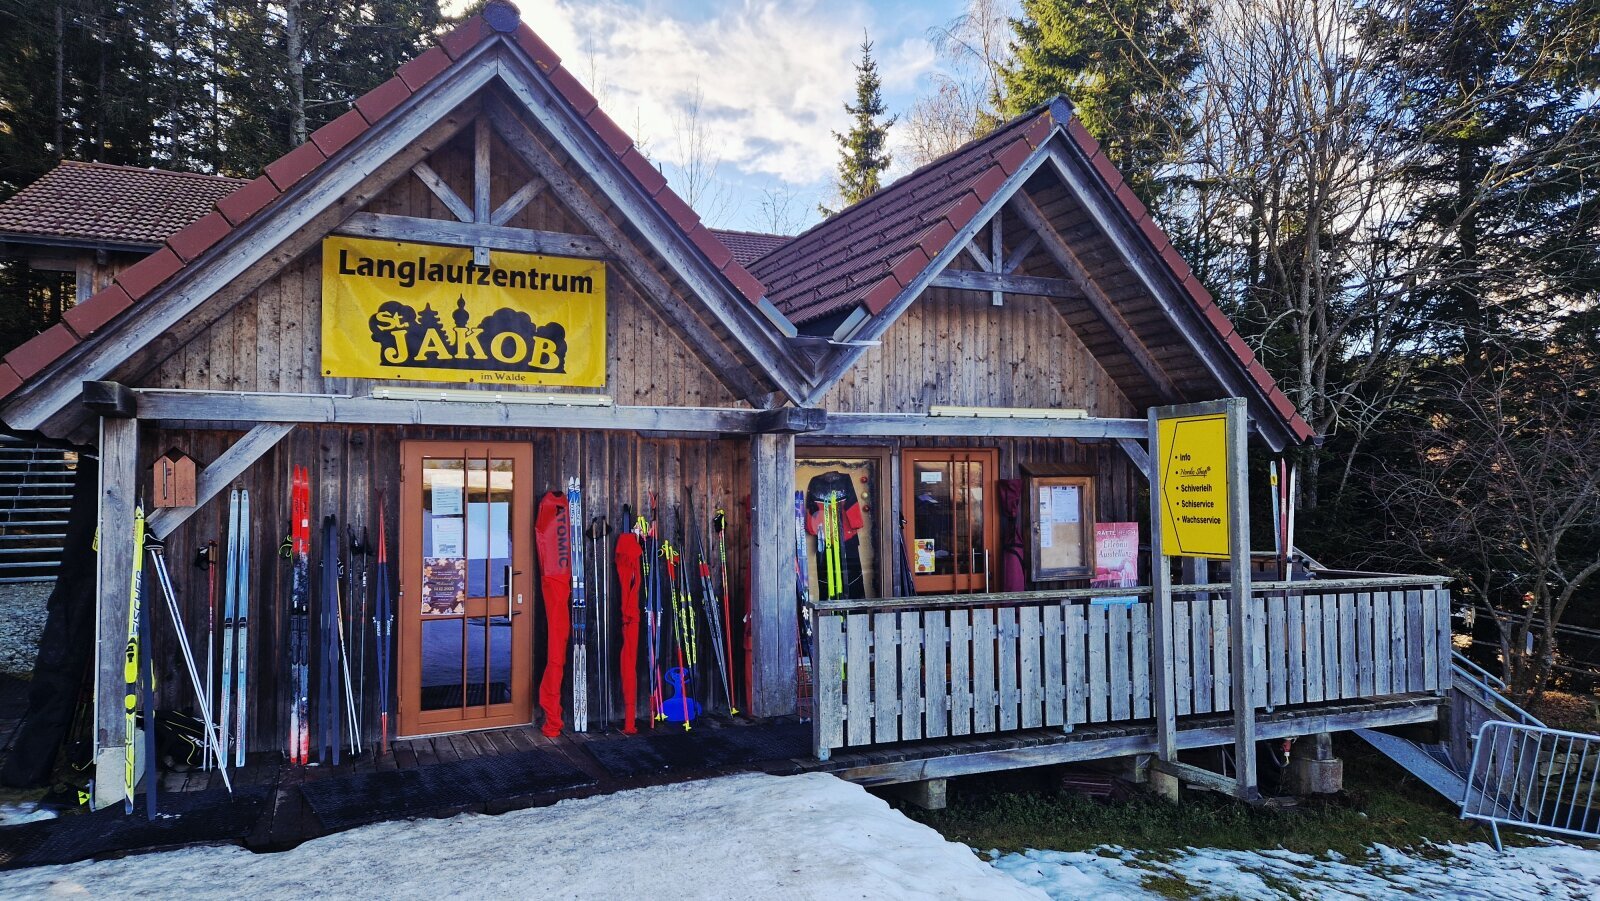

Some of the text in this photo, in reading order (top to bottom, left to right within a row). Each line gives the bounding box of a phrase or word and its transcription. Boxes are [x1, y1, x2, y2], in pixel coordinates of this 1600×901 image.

[339, 249, 593, 294] Langlaufzentrum
[384, 327, 560, 370] JAKOB
[481, 373, 527, 382] im Walde
[1180, 453, 1191, 461] Info
[1181, 484, 1212, 492] Schiverleih
[1182, 500, 1214, 508] Schiservice
[1182, 516, 1221, 525] Wachsservice
[555, 504, 569, 569] ATOMIC
